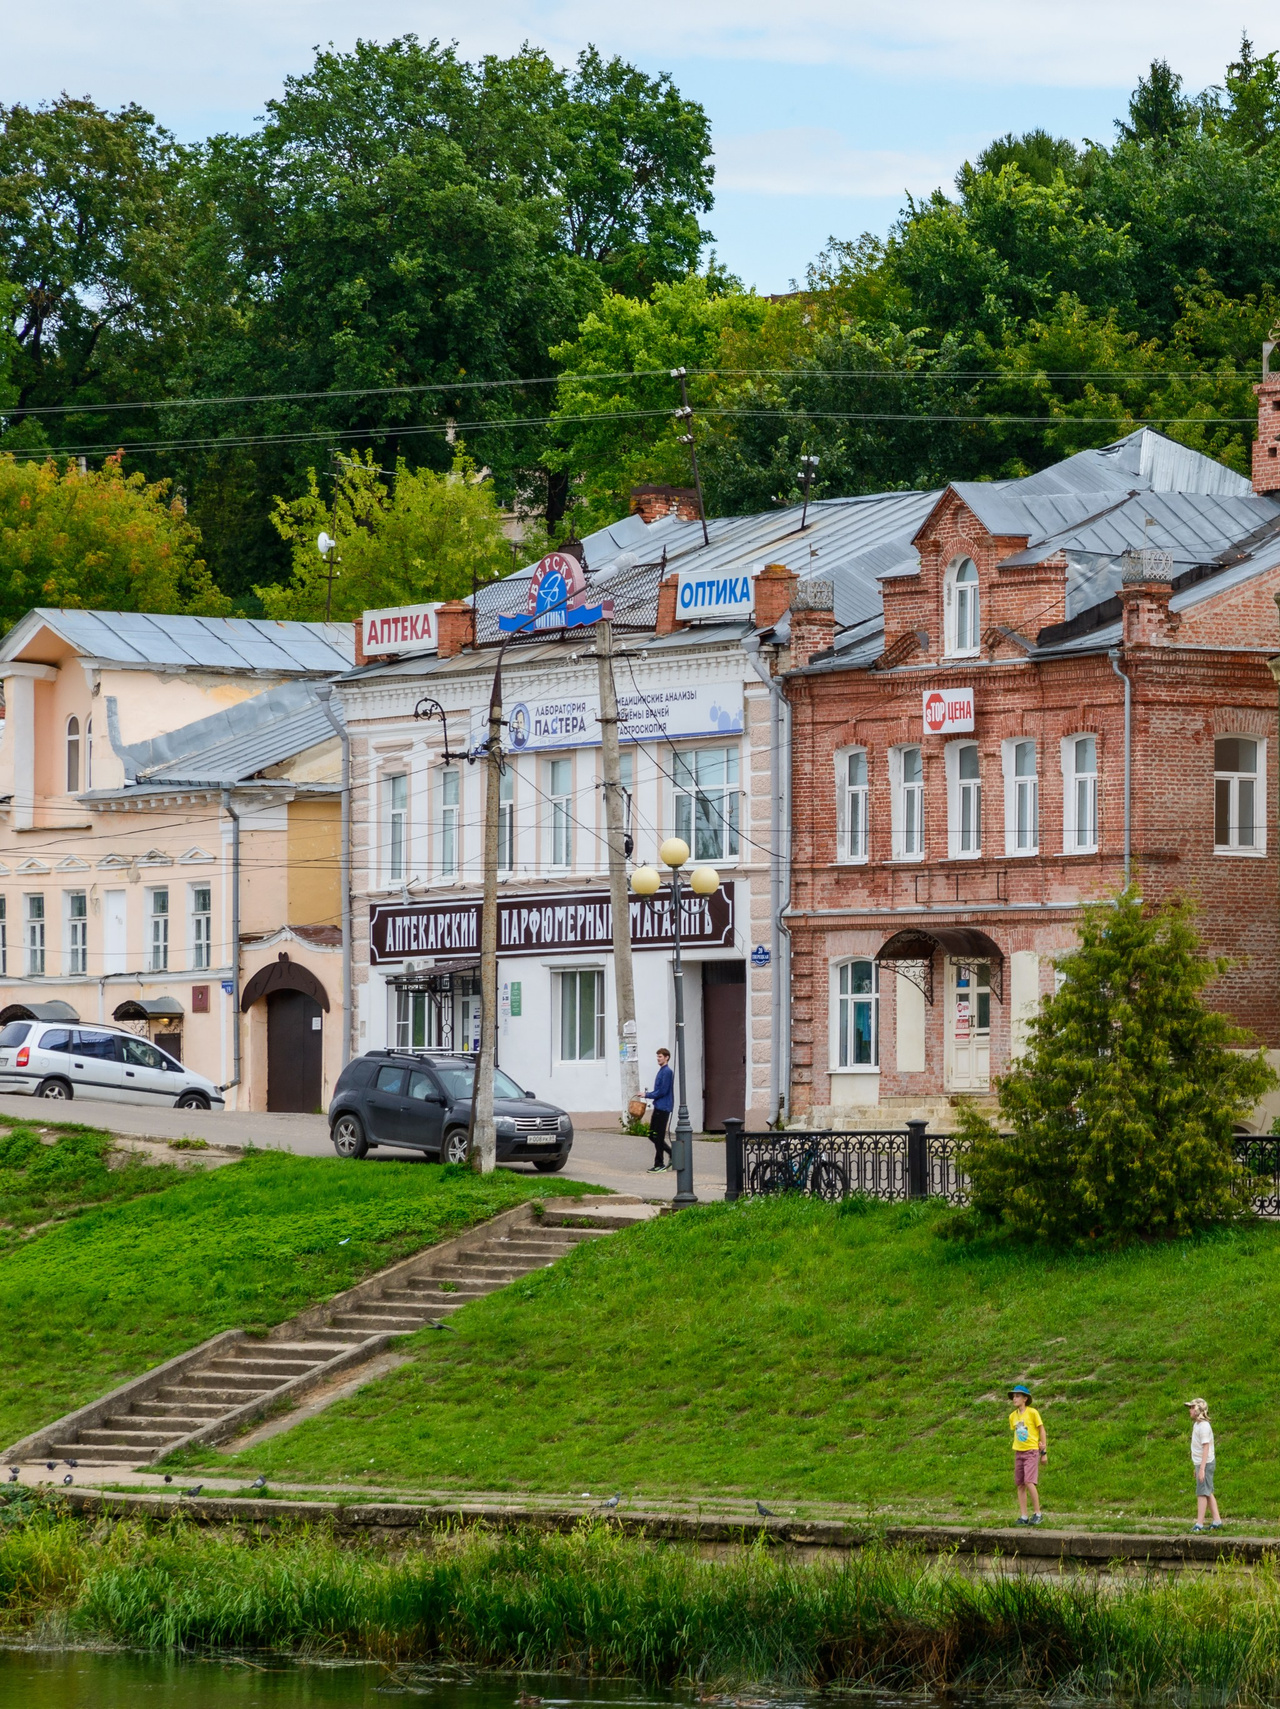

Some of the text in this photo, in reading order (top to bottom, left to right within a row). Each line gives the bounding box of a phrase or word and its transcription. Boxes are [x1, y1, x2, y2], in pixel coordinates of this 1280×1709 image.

[680, 576, 751, 609] ОПТИКА
[367, 613, 432, 646] АПТЕКА
[665, 690, 697, 702] АНАЛИЗЫ
[535, 702, 586, 717] ЛАБОРАТОРИЯ
[646, 705, 669, 719] ВРАЧЕЙ
[947, 700, 972, 723] ЦЕНА
[535, 716, 587, 736] ПАСТЕРА
[385, 908, 477, 952] АПТЕКАРСКИЙ
